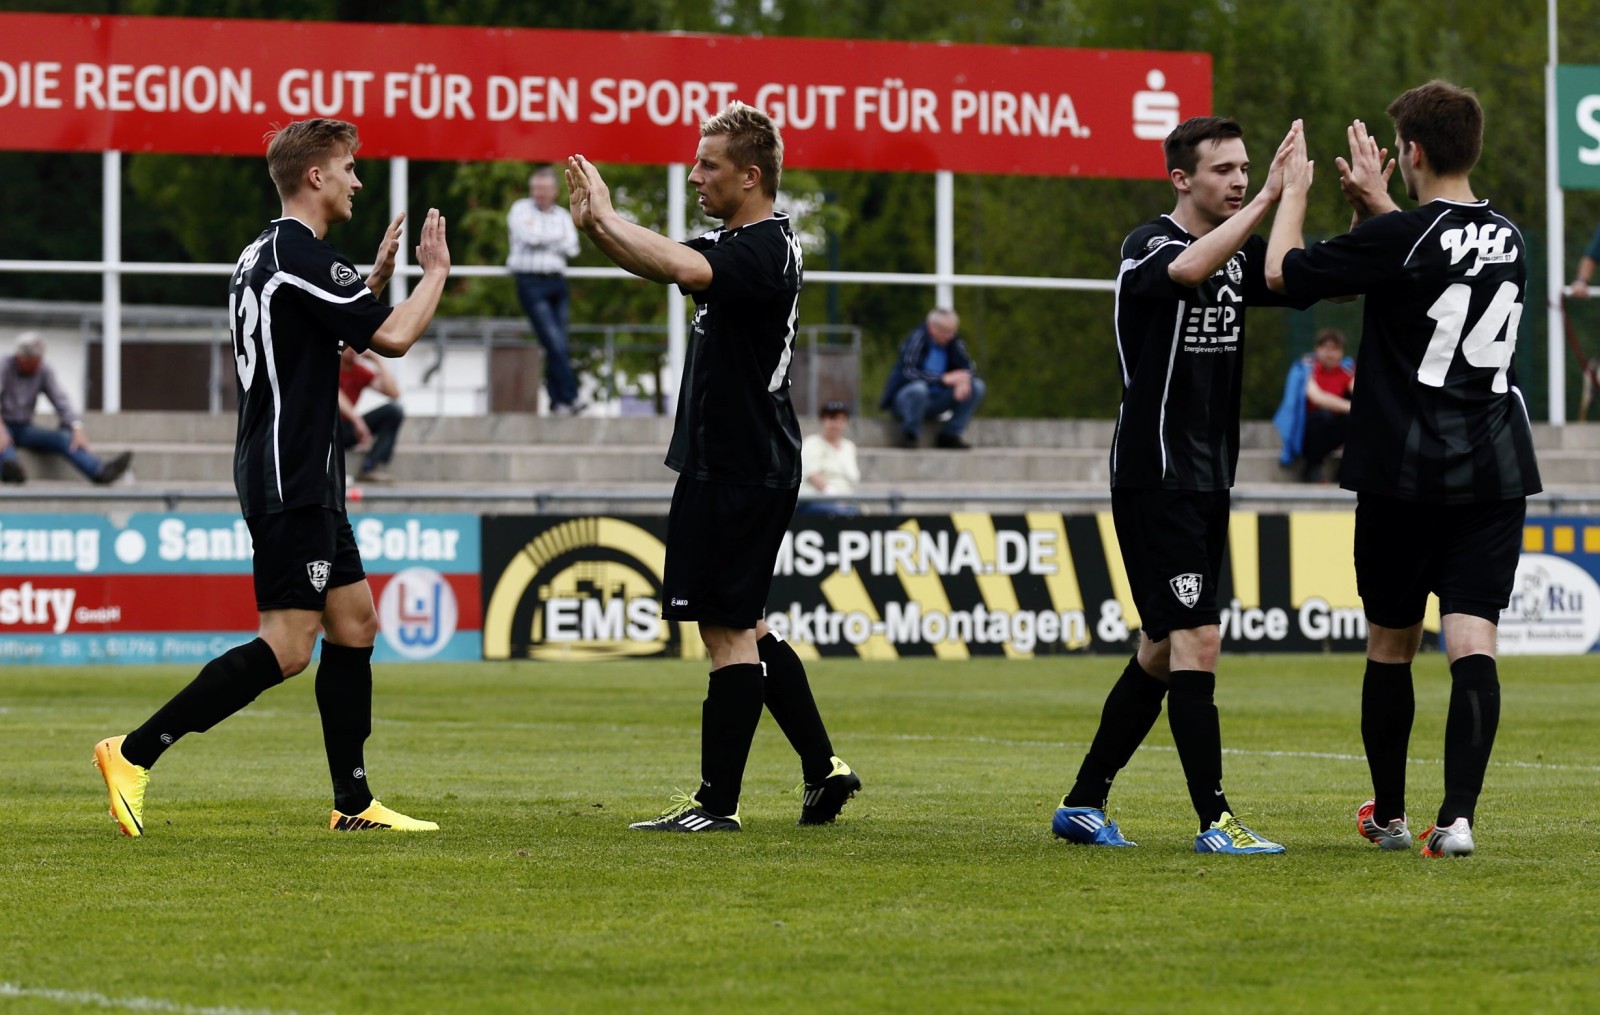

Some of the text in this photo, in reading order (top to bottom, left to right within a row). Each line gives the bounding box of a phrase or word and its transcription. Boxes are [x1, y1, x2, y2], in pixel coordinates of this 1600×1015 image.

[0, 61, 62, 108] DIE
[75, 63, 265, 115] REGION.
[278, 69, 374, 117] GUT
[385, 64, 474, 120] FÜR
[488, 76, 578, 122] DEN
[755, 83, 845, 130] GUT
[855, 78, 941, 133] FÜR
[952, 90, 1091, 138] PIRNA.
[1417, 280, 1523, 394] 14
[158, 517, 254, 561] Sani
[357, 518, 460, 561] Solar
[0, 581, 121, 634] stry GmbH
[545, 597, 661, 642] EMS
[1097, 598, 1129, 642] &
